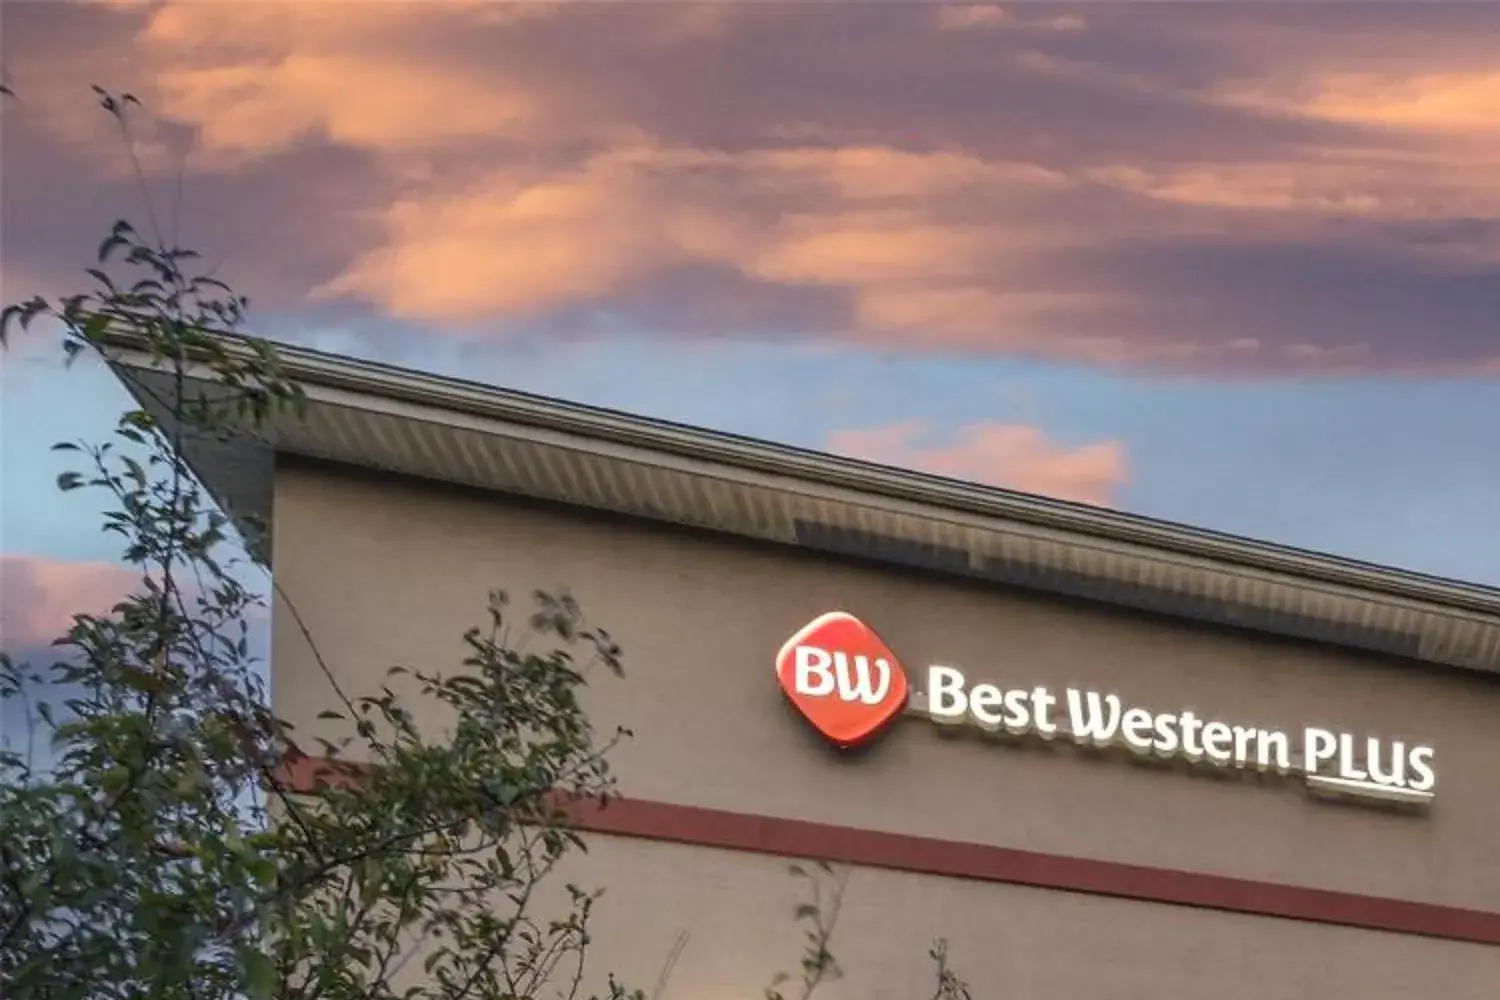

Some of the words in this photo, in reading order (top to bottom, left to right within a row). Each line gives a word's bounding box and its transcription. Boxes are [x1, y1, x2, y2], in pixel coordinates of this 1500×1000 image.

[795, 646, 890, 703] BW
[927, 665, 1056, 734] Best
[1066, 689, 1290, 769] Western
[1305, 727, 1436, 789] PLUS
